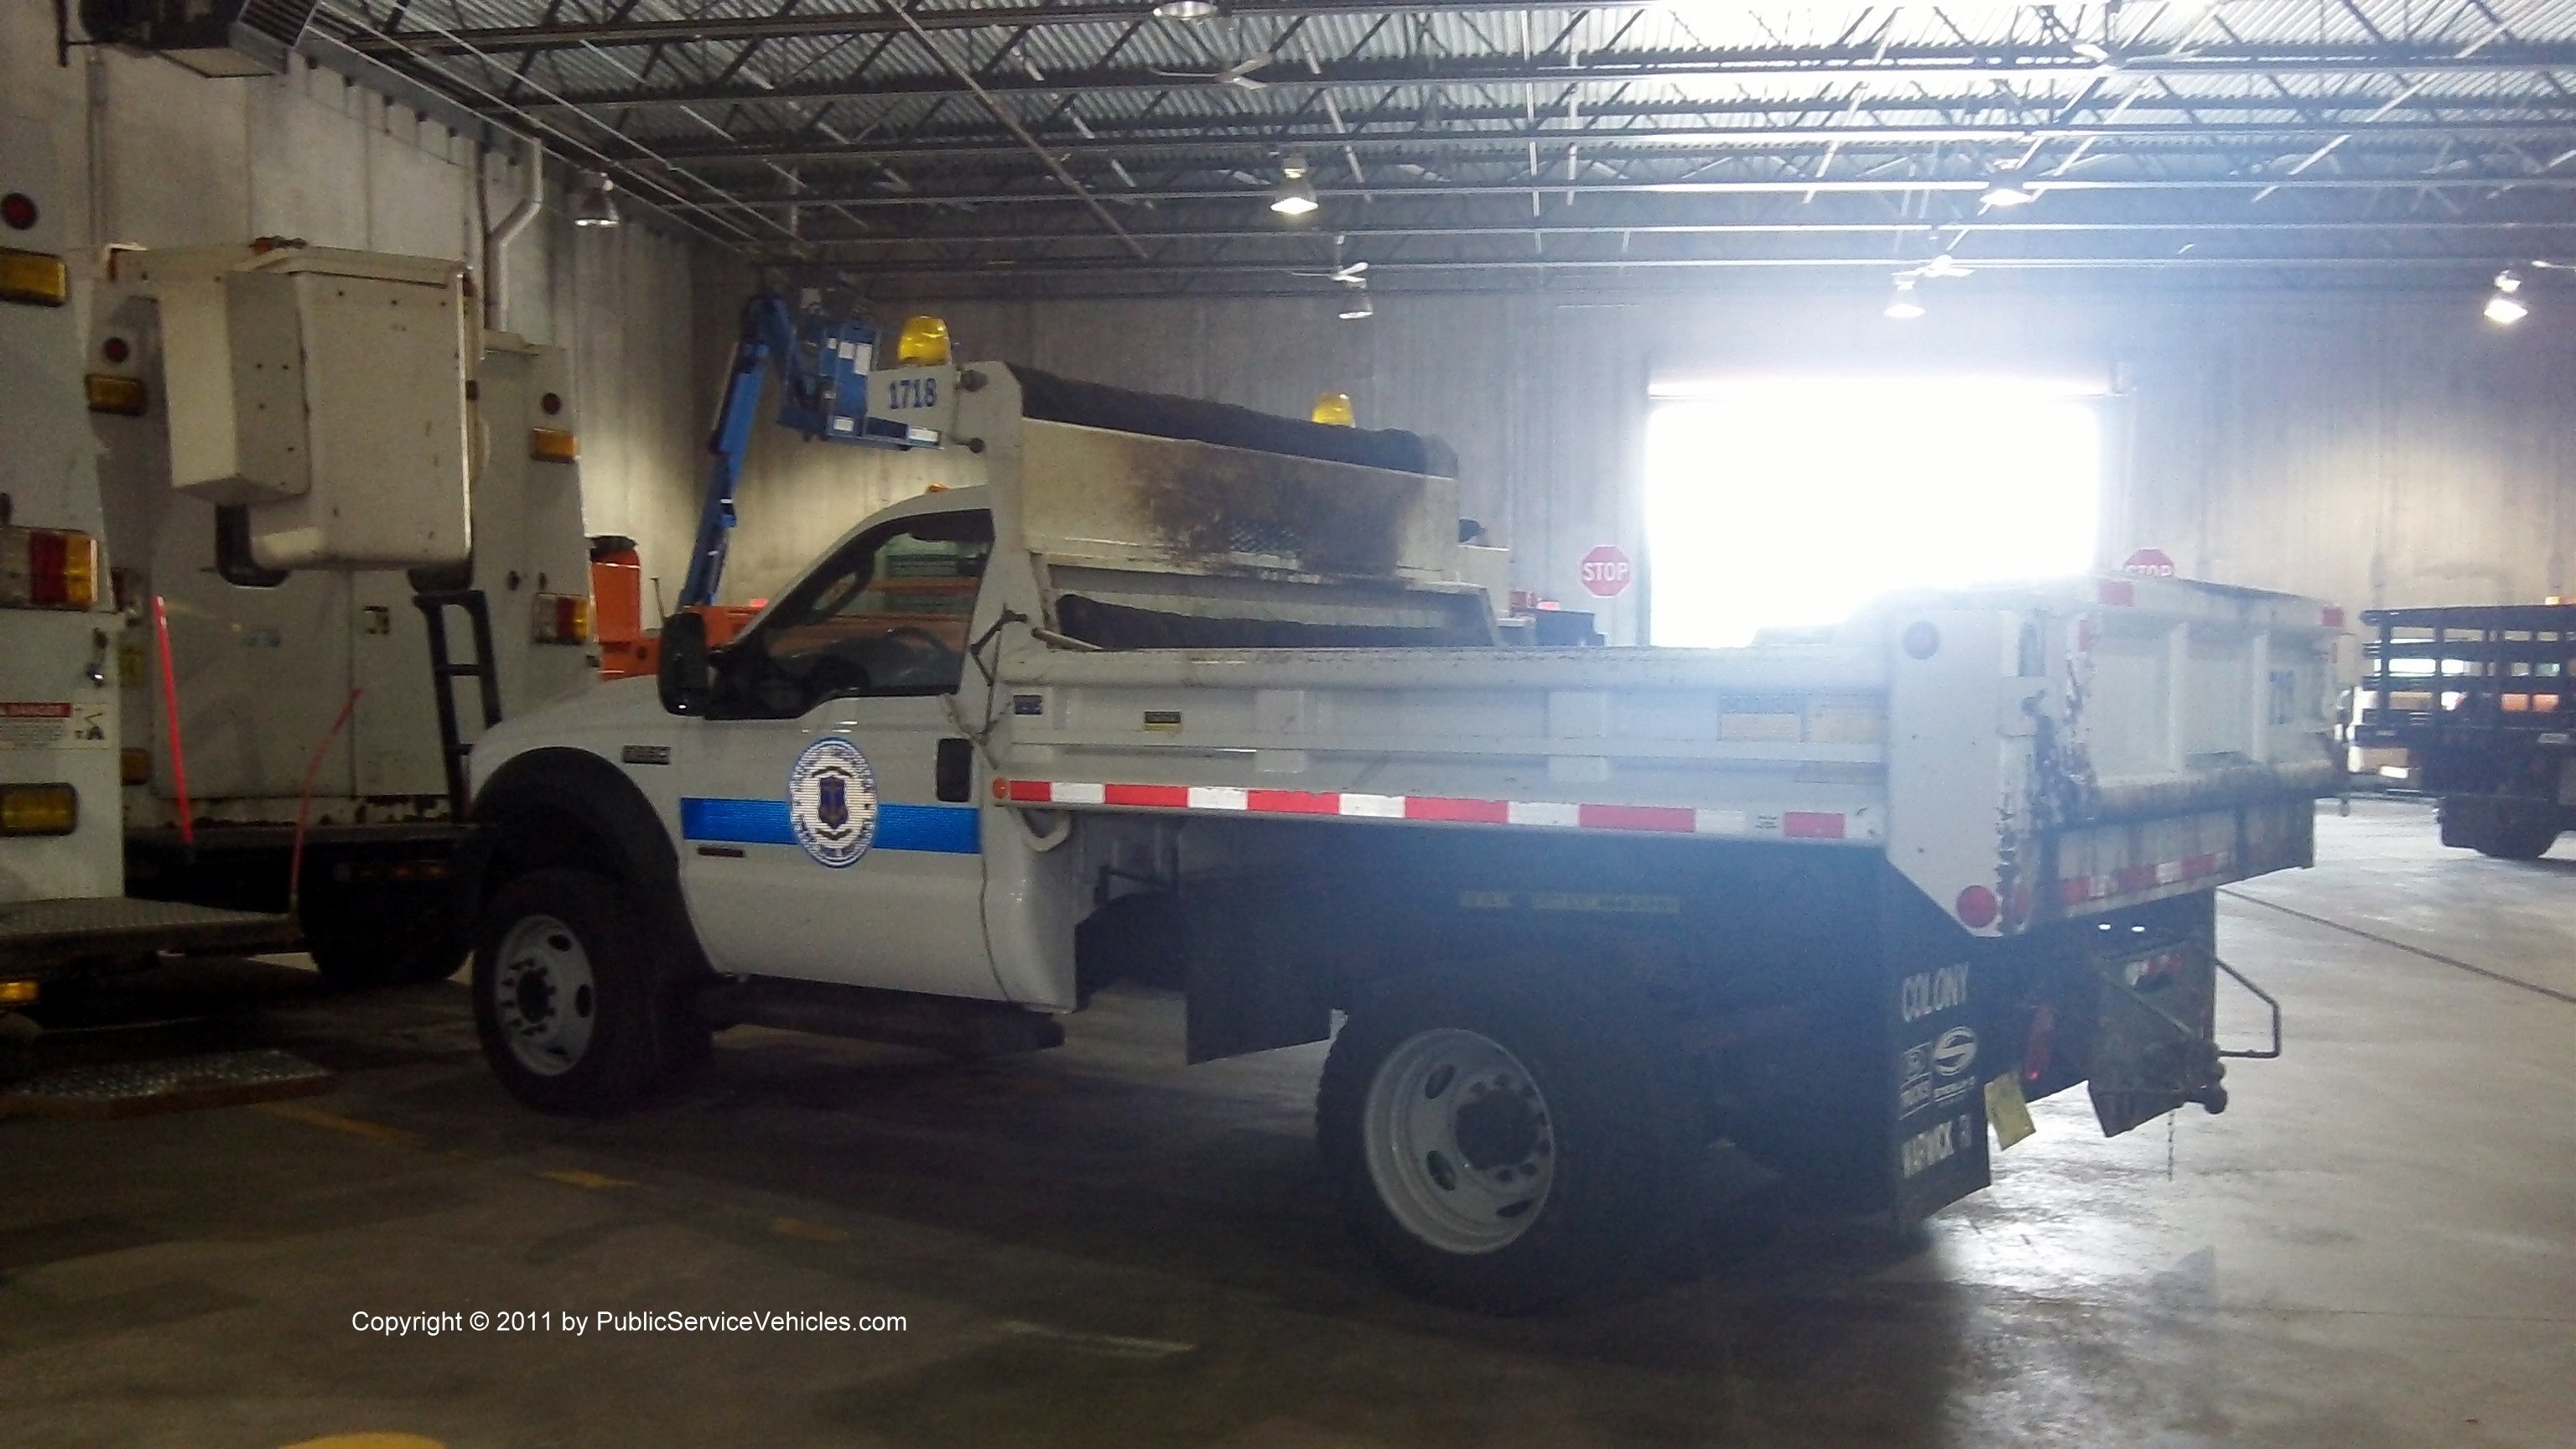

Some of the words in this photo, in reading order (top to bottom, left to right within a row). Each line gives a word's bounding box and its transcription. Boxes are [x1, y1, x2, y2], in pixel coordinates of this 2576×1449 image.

[889, 377, 938, 410] 1718
[1582, 562, 1628, 581] STOP
[1901, 962, 1969, 1022] COLONY
